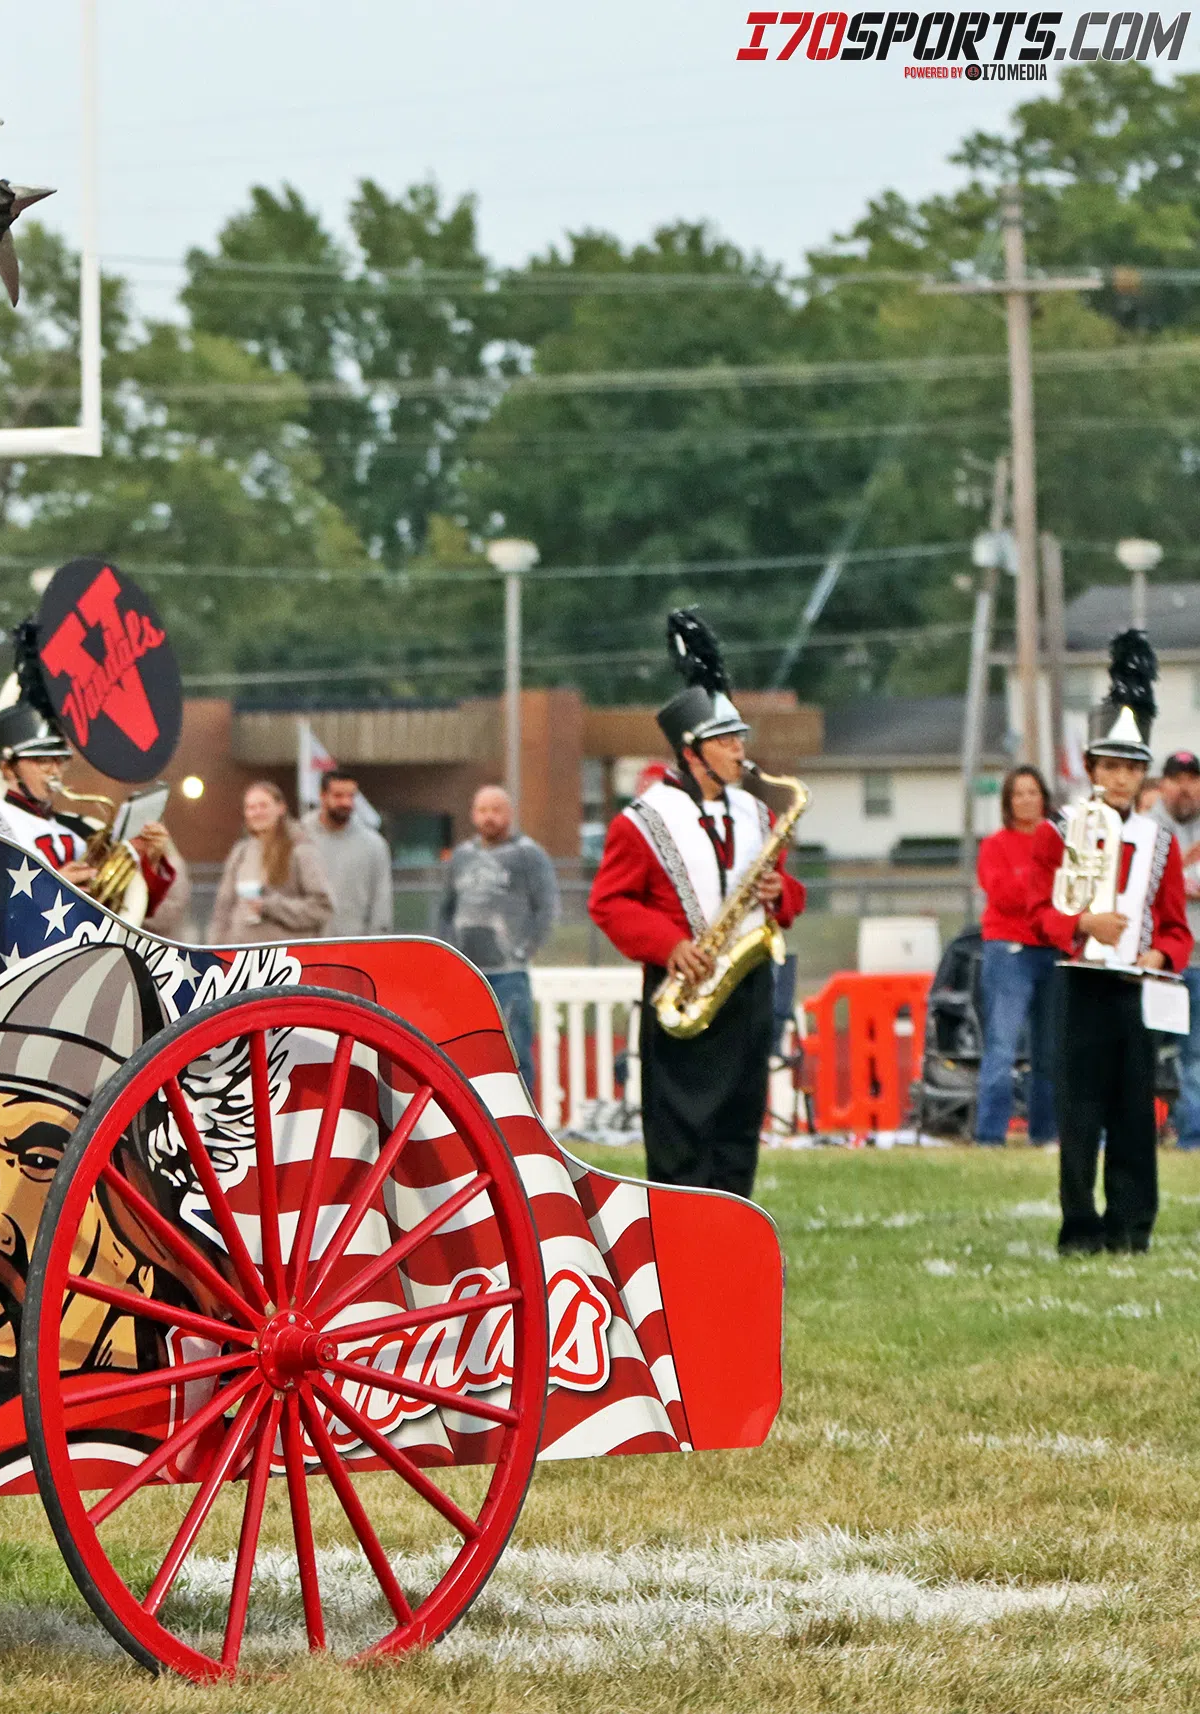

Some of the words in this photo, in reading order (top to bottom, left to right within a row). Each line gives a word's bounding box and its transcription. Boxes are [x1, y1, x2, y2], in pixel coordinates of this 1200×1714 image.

[40, 566, 159, 752] V
[62, 610, 166, 747] Vandals
[698, 815, 735, 870] V
